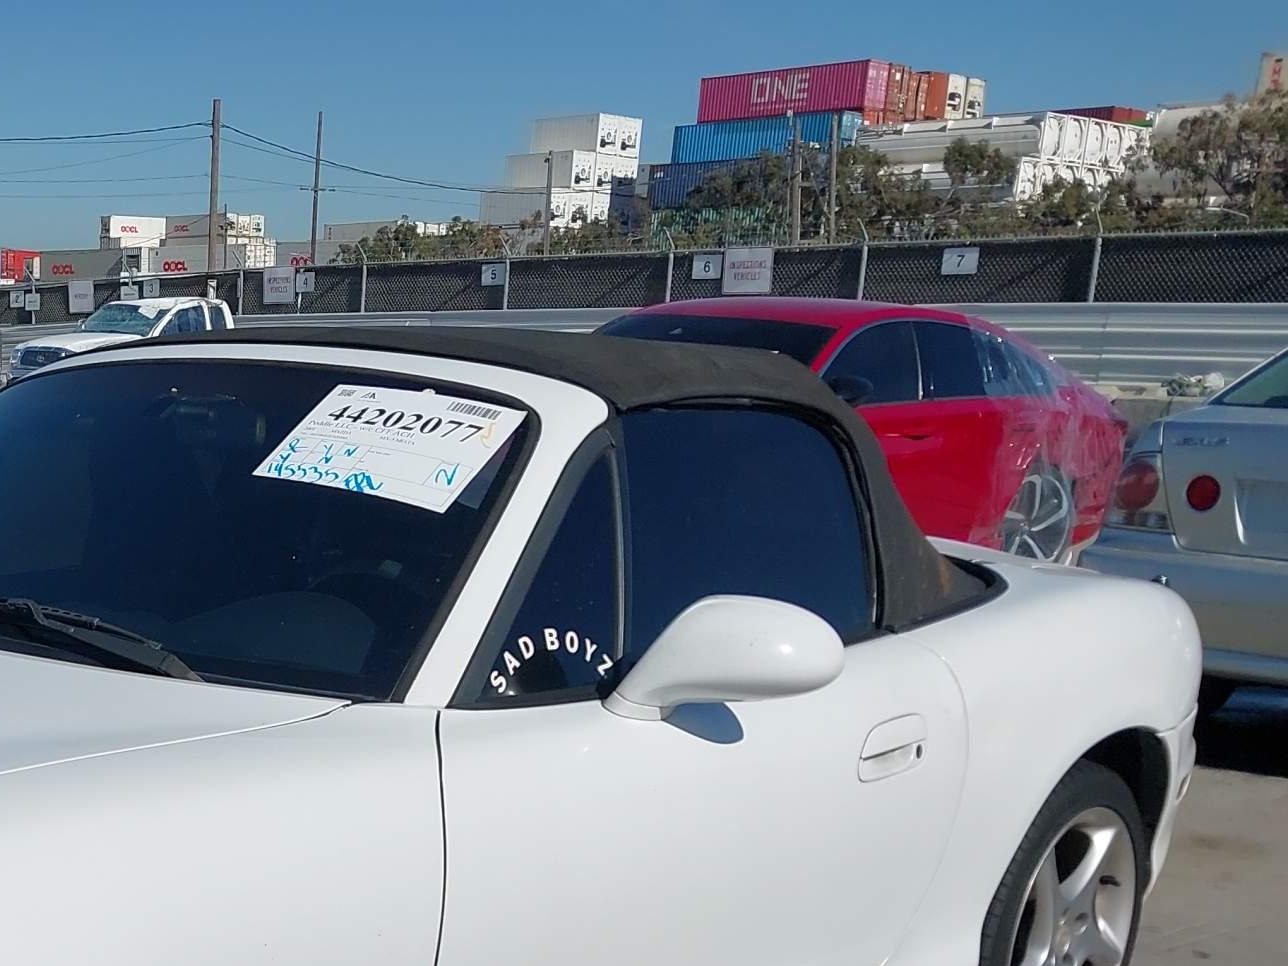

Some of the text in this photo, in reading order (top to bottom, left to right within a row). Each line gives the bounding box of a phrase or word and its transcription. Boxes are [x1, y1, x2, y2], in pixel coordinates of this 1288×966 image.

[751, 73, 809, 104] ONE
[120, 225, 139, 234] OOCL
[163, 260, 188, 272] OOCL
[703, 261, 711, 273] 6
[957, 254, 966, 268] 7
[52, 263, 75, 275] OOCL
[490, 269, 497, 280] 5
[327, 404, 485, 442] 44202077
[489, 627, 615, 694] SAD BOYZ
